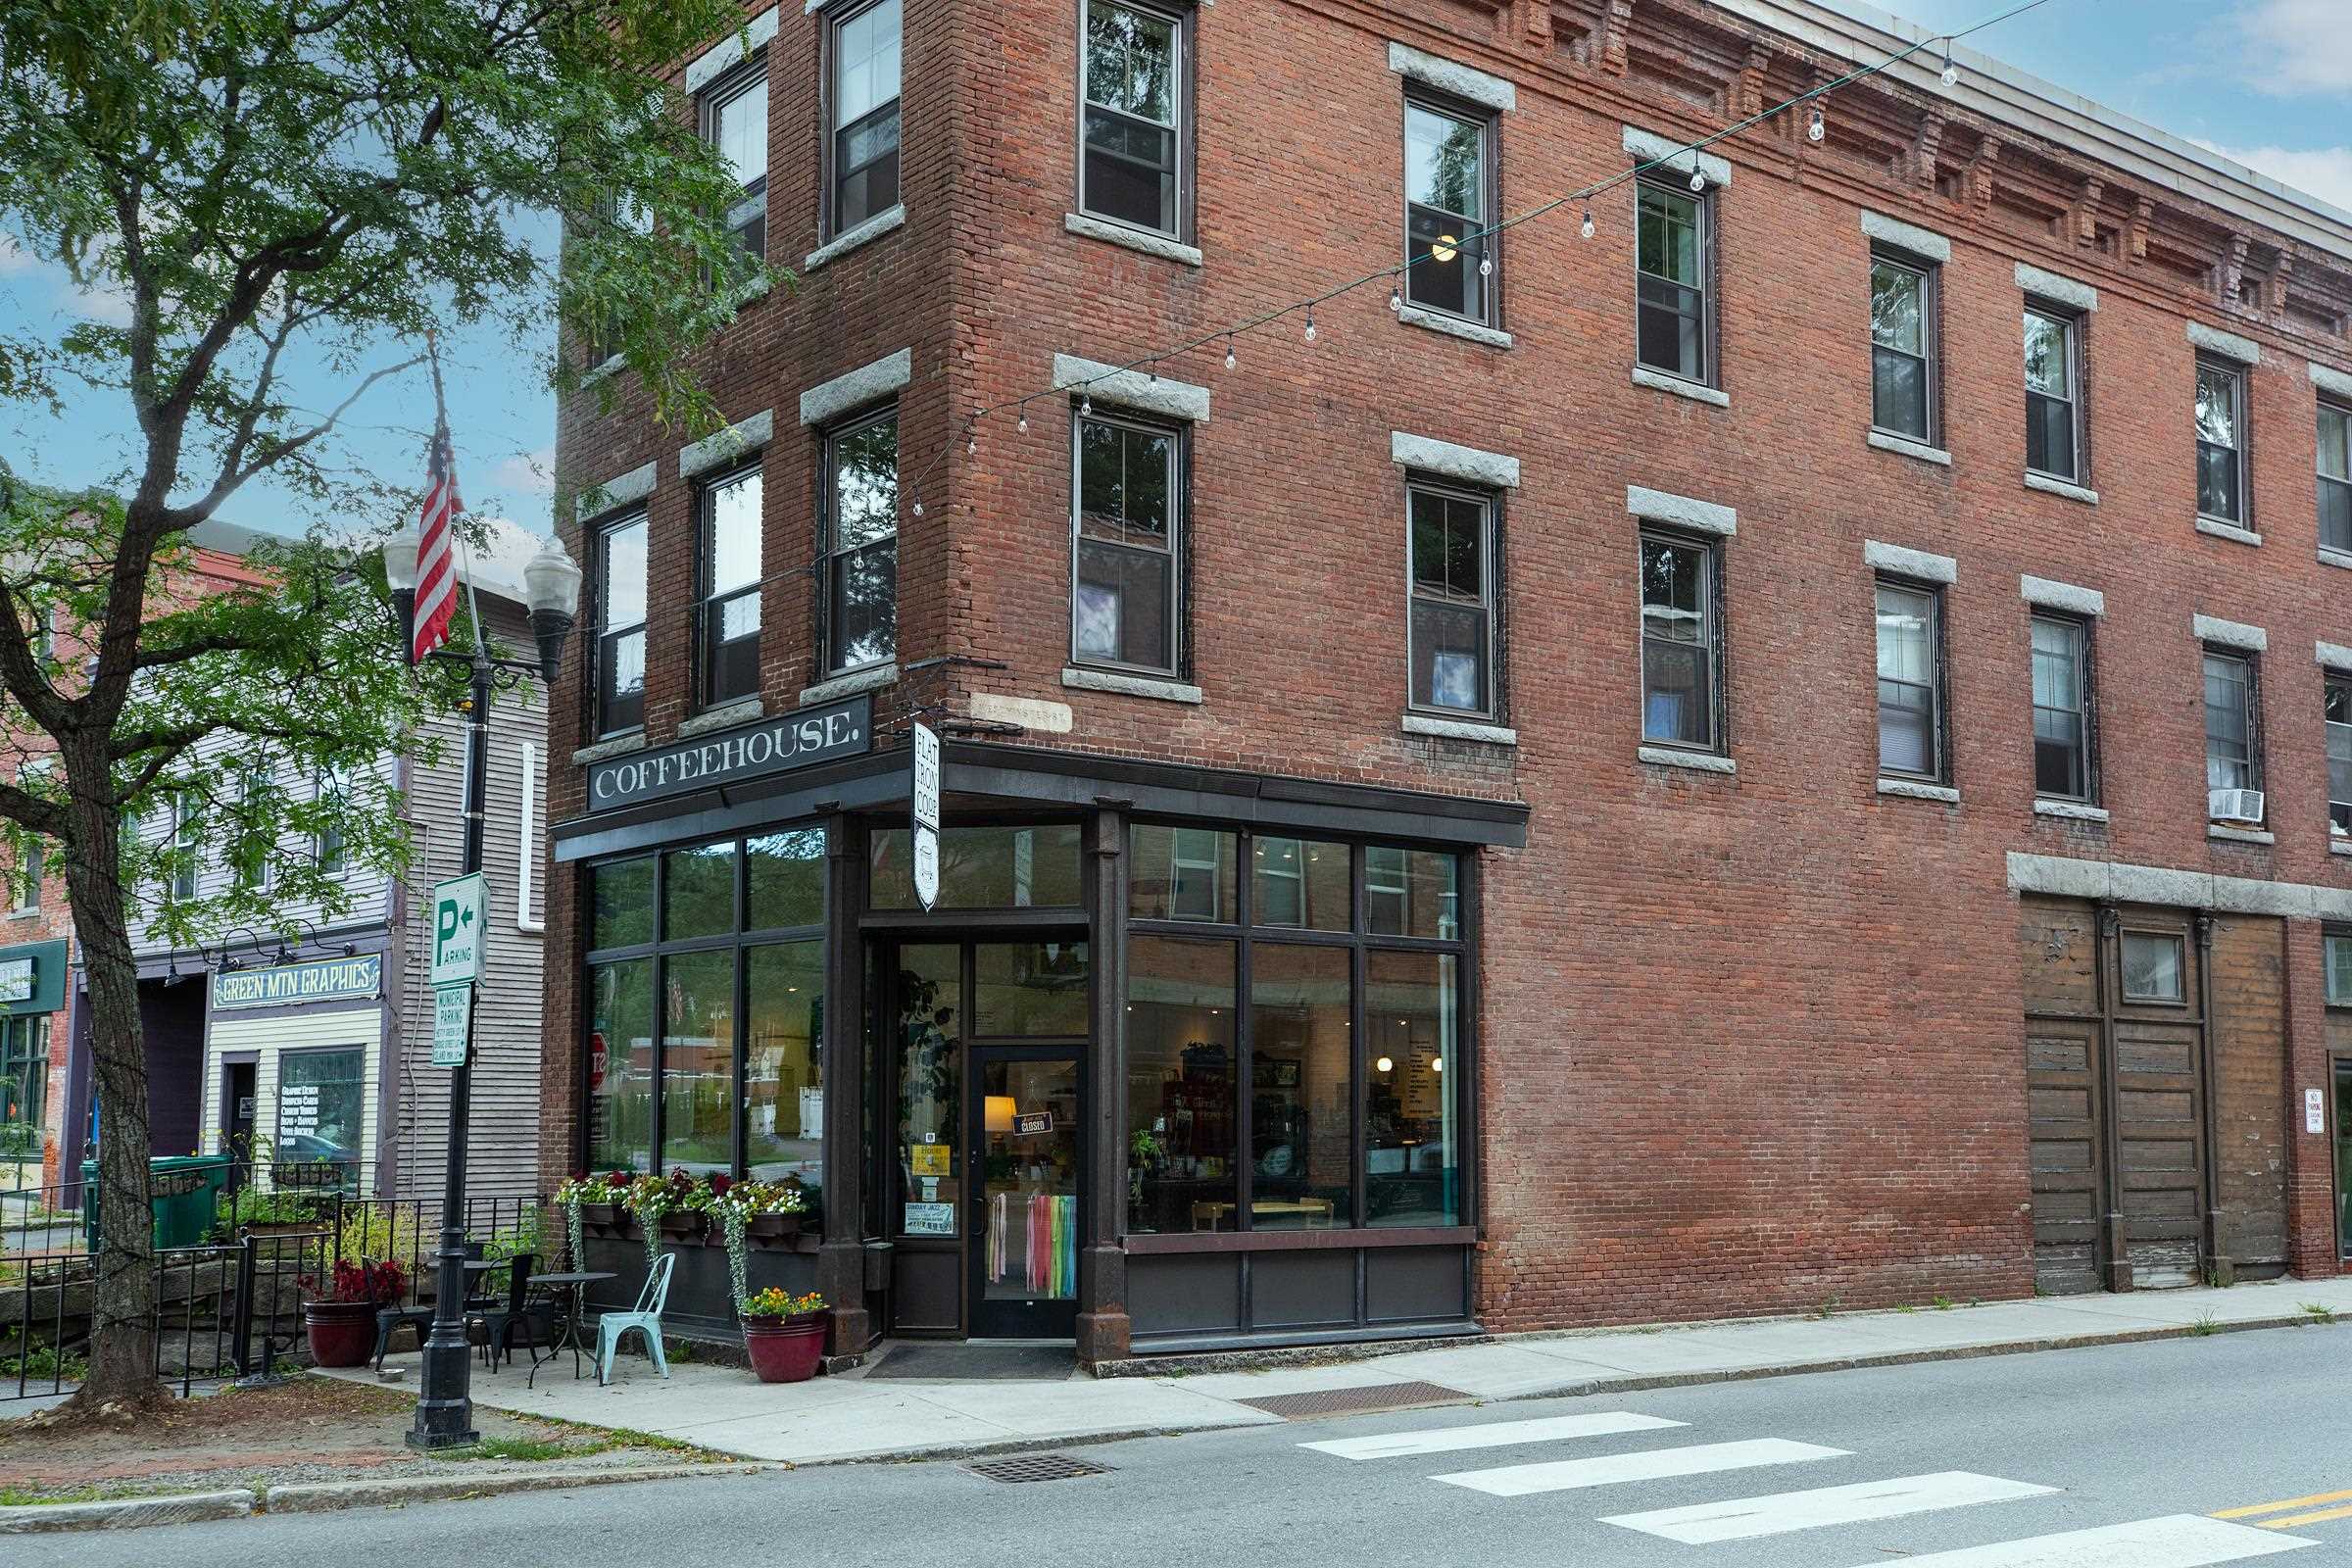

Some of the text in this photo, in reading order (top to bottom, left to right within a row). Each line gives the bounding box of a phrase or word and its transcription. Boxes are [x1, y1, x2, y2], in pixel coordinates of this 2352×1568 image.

[595, 710, 859, 800] COFFEEHOUSE.
[917, 731, 938, 766] FLAT
[917, 760, 938, 792] IRON
[222, 962, 370, 1002] GREEN MTN GRAPHICS
[438, 990, 466, 1007] MUNICIPAL
[440, 1008, 463, 1026] PARKING
[1021, 1120, 1045, 1133] CLOSED
